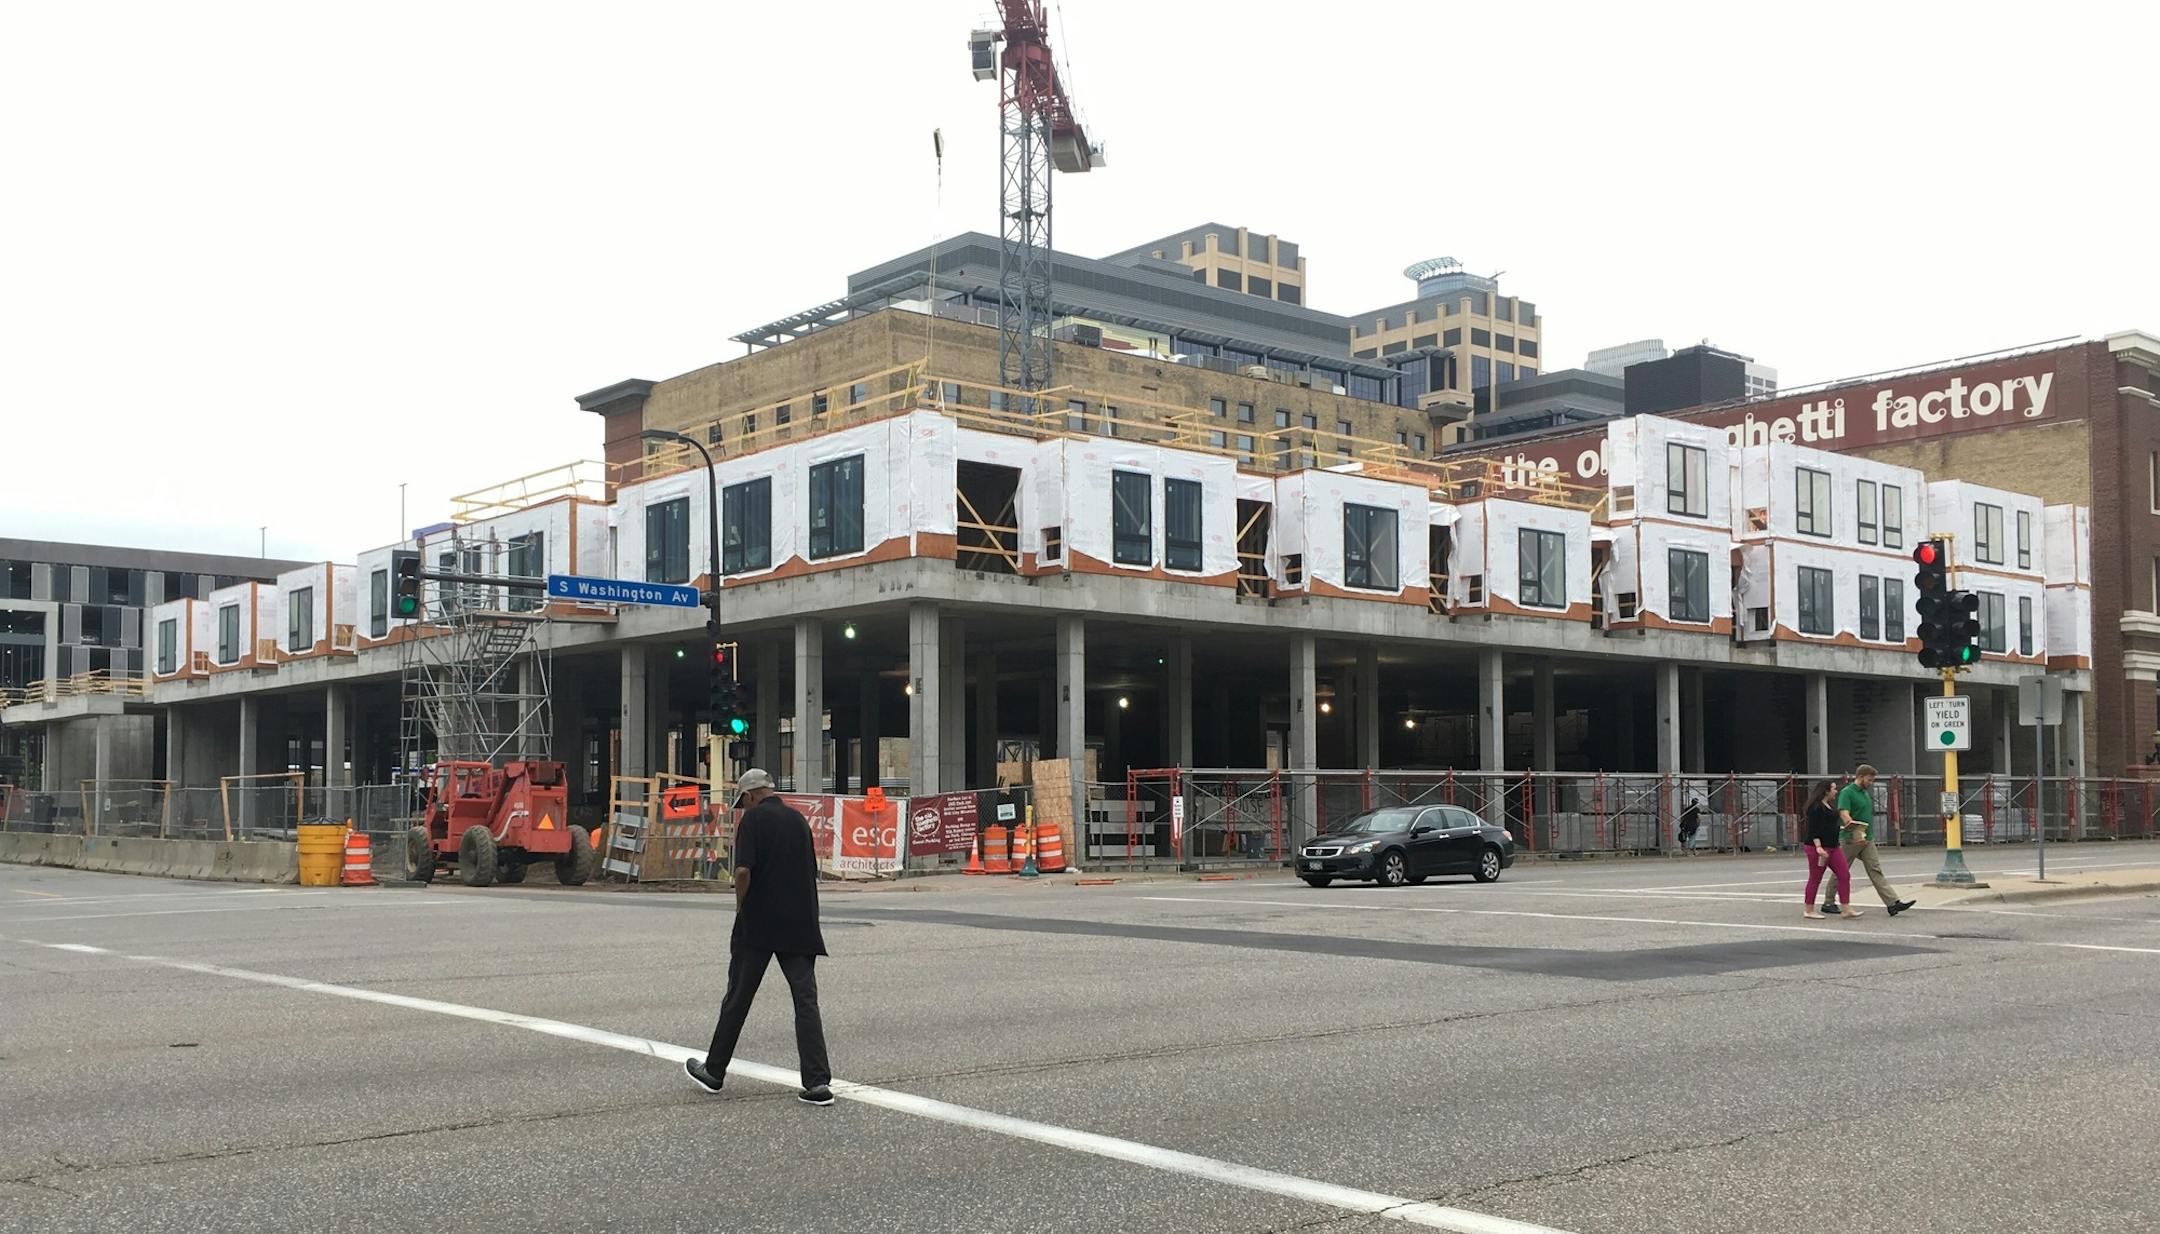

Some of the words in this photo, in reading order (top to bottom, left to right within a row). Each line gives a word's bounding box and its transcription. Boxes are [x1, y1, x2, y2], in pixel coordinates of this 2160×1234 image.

[1501, 452, 1560, 490] the
[1577, 438, 1608, 479] ol
[1723, 398, 1846, 449] ghetti
[1872, 372, 2055, 432] factory
[559, 580, 569, 593] S
[578, 582, 663, 602] Washington
[672, 590, 689, 603] Av
[1929, 701, 1944, 709] LEFT
[1936, 710, 1960, 719] YIELD
[1931, 721, 1940, 729] ON
[1944, 720, 1965, 728] GREEN
